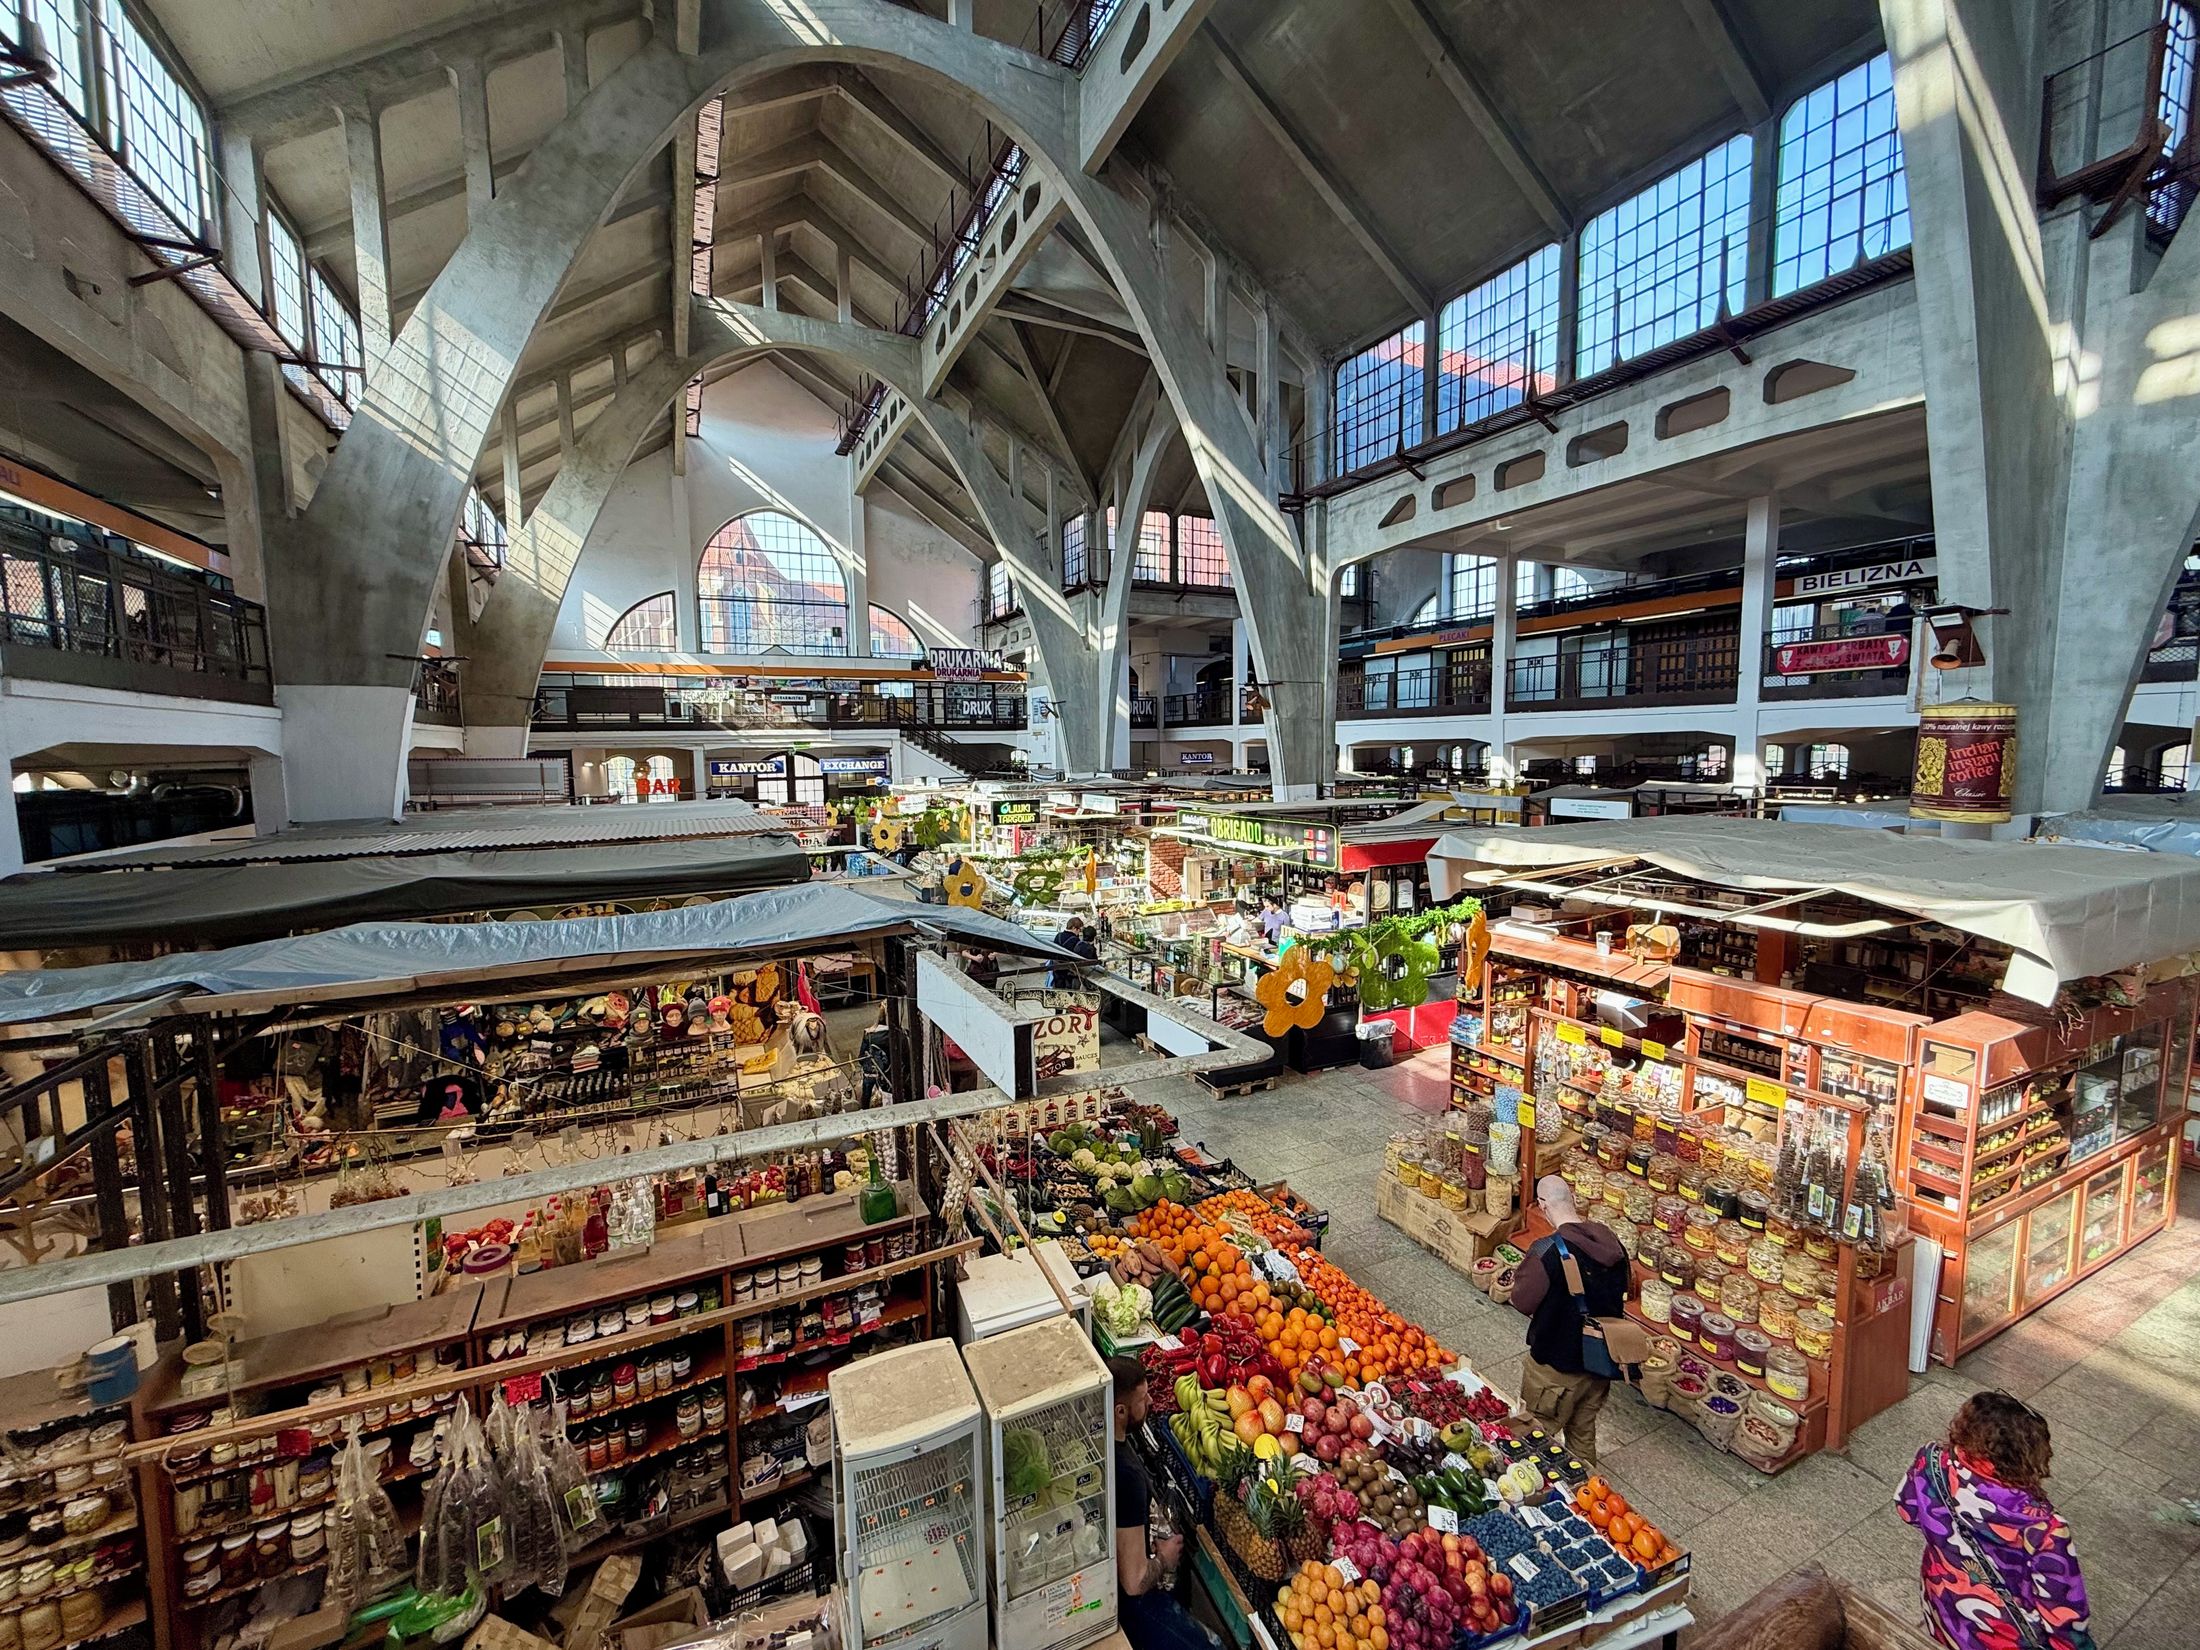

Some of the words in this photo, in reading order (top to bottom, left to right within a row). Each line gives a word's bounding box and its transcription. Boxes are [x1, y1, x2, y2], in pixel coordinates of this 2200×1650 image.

[1802, 560, 1924, 591] BIELIZNA
[1439, 631, 1470, 642] PLECAKI
[1796, 645, 1825, 656] KAWY
[929, 648, 1002, 669] DRUKARNIA
[936, 668, 980, 677] DRUKARNIA
[961, 700, 993, 716] DRUK
[1972, 723, 1992, 732] kawy
[1950, 740, 2001, 760] indian
[1181, 752, 1213, 761] KANTOR
[718, 760, 778, 773] KANTOR
[823, 760, 885, 770] EXCHANGE
[1947, 766, 1994, 783] coffee
[636, 778, 682, 795] BAR
[1953, 787, 1987, 798] Classic
[1000, 802, 1031, 814] OLIWKI
[996, 814, 1036, 823] TARGOWA
[1210, 816, 1262, 844] OBRIGADO
[1075, 1052, 1098, 1062] SAUCES
[1038, 1060, 1068, 1079] RAZOR
[1876, 1290, 1905, 1312] AKBAR
